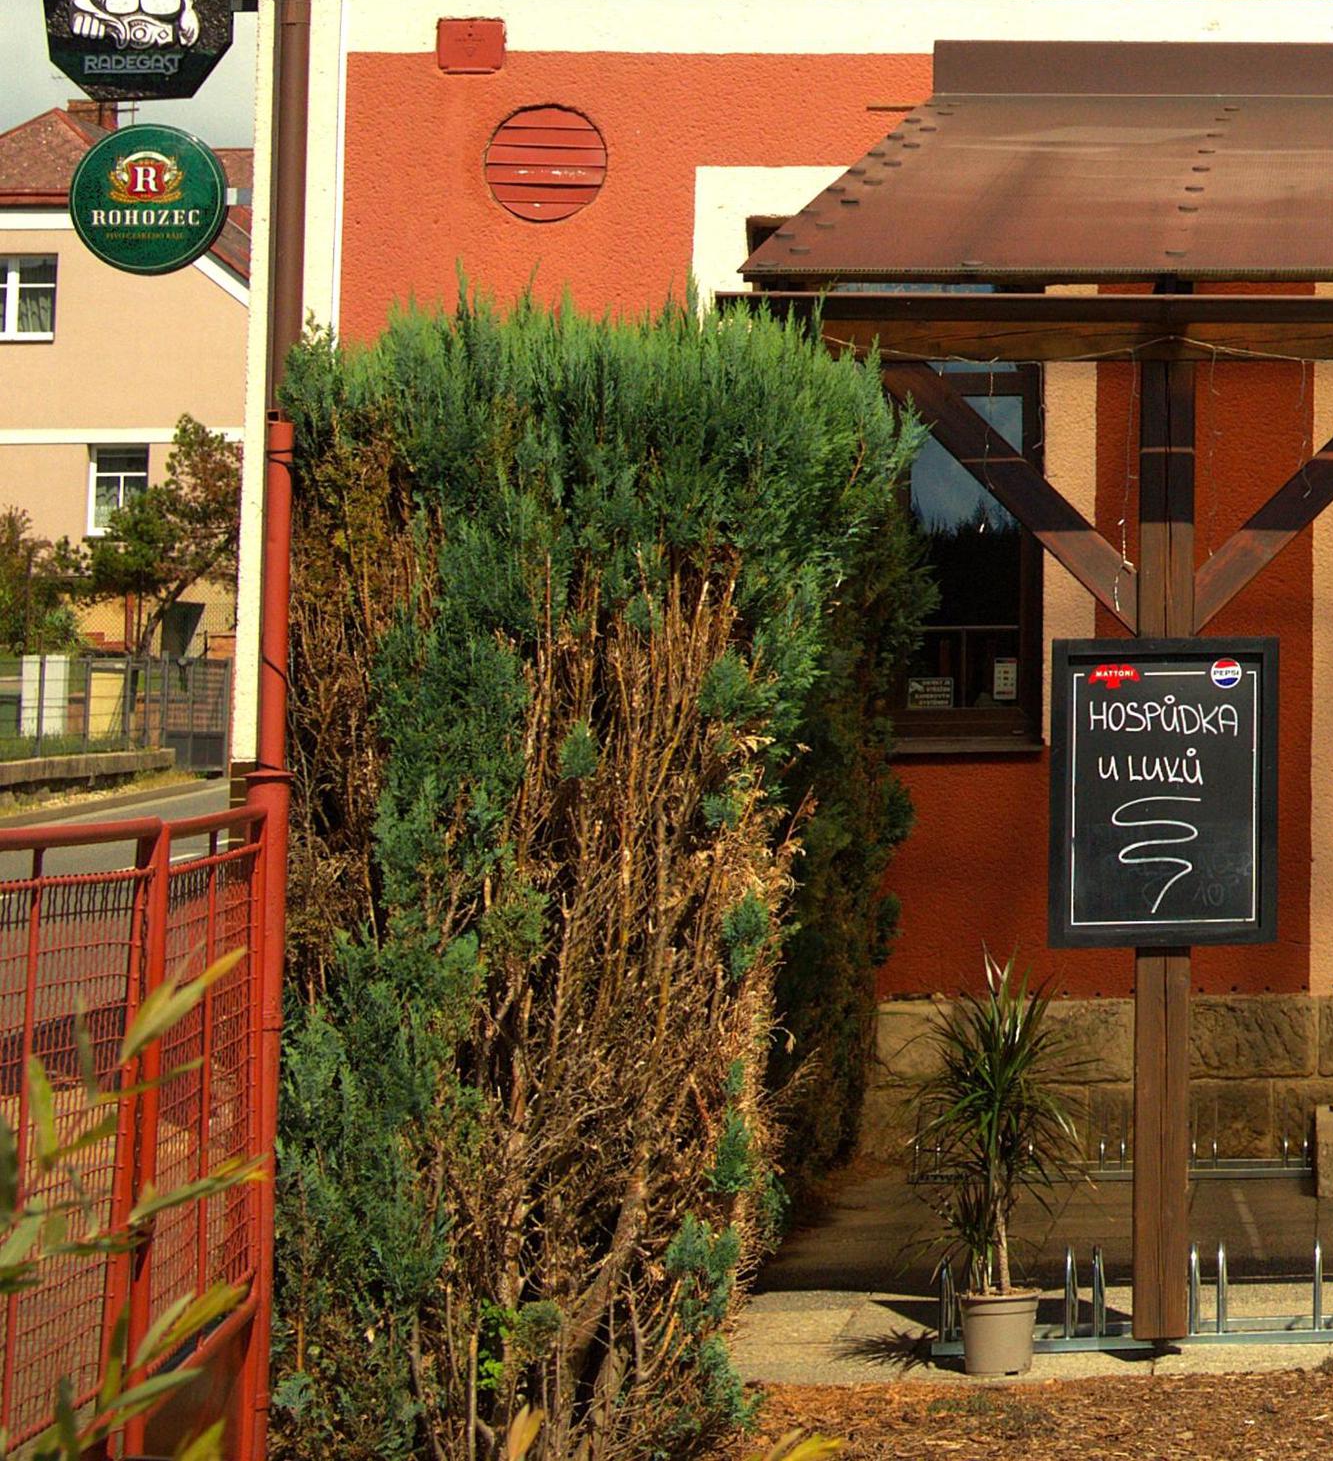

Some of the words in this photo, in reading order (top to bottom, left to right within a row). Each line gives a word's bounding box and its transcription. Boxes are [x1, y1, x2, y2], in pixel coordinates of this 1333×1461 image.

[84, 54, 184, 76] RADEGAST
[132, 166, 159, 192] R
[92, 209, 200, 226] ROHOZEC
[1095, 669, 1134, 677] MATTONI
[1213, 669, 1240, 677] PEPSI
[1089, 695, 1238, 737] HOSPŮDKA
[1098, 755, 1120, 781] U
